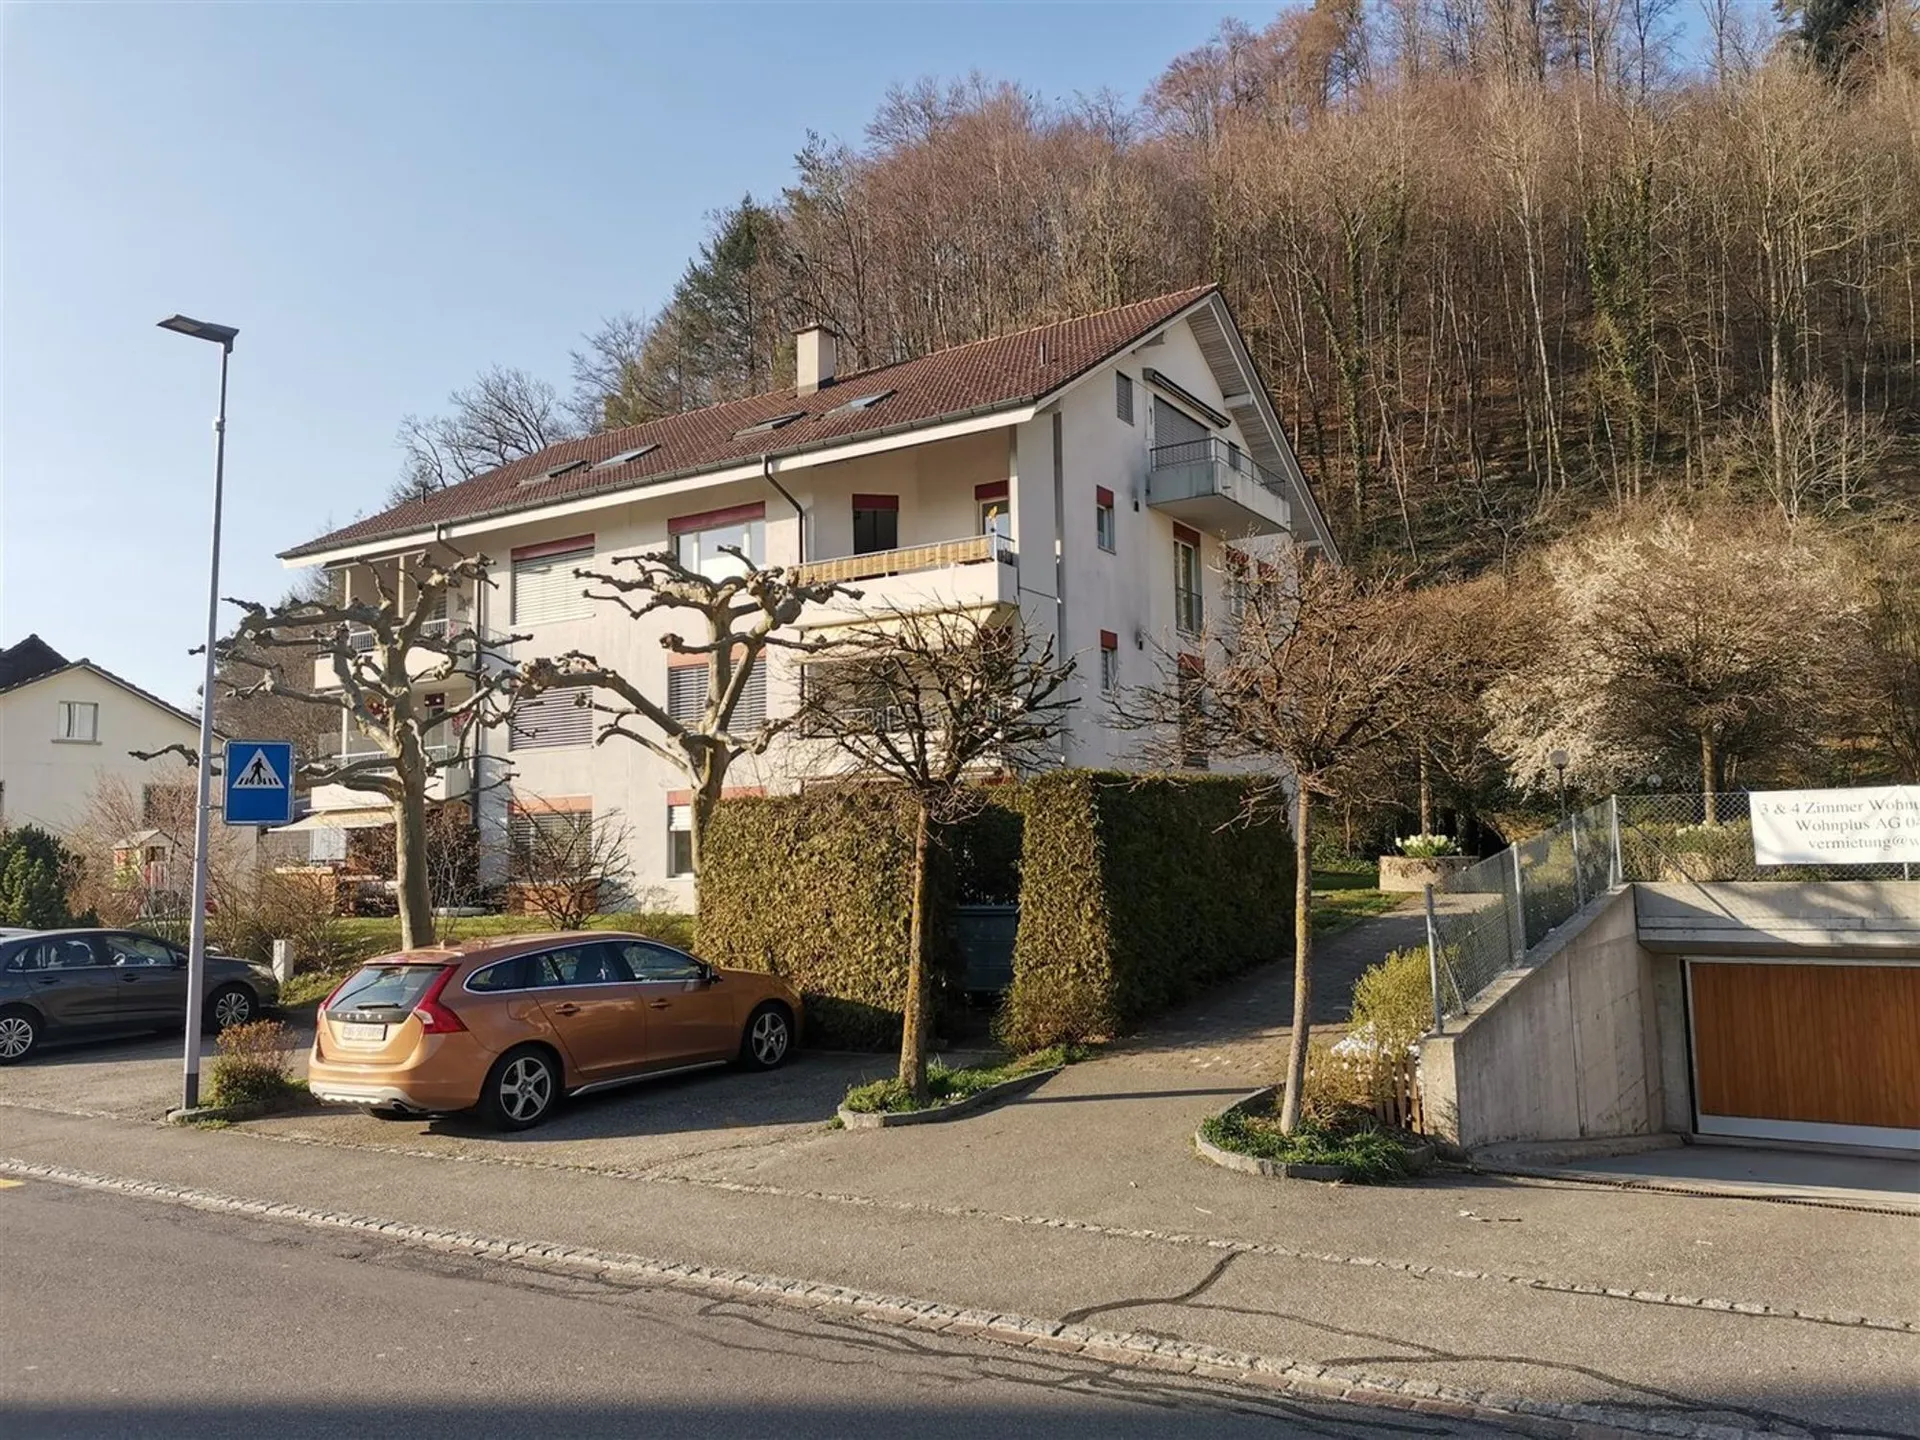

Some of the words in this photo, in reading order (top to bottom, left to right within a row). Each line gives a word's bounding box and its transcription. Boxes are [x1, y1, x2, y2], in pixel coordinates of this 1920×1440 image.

[1760, 803, 1769, 816] 3
[1773, 803, 1786, 815] &
[1791, 802, 1800, 814] 4
[1805, 801, 1864, 814] Zimmer
[1795, 818, 1870, 834] Wohnplus
[1875, 816, 1901, 829] AG
